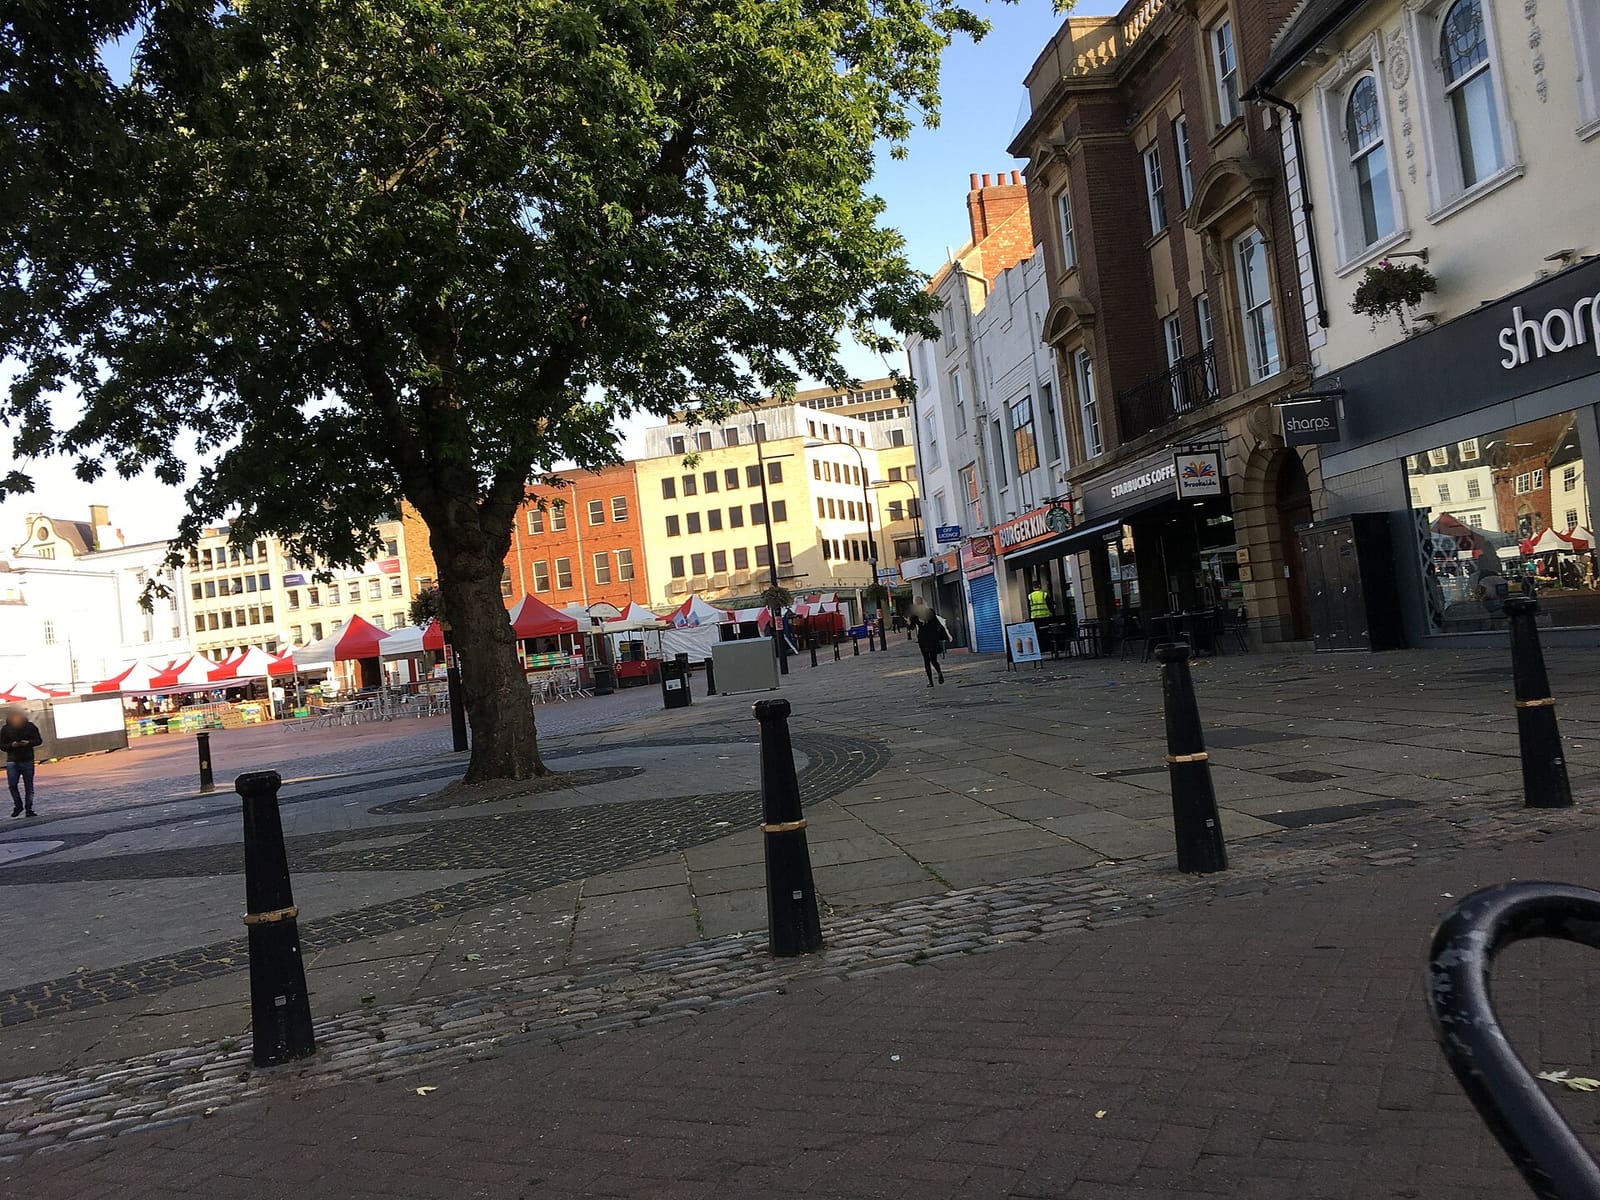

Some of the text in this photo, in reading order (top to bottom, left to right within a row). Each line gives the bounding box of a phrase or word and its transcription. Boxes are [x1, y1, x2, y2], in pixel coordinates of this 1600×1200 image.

[1287, 417, 1330, 431] sharps
[1111, 473, 1151, 498] STARBUCKS
[999, 519, 1031, 548] BURGER
